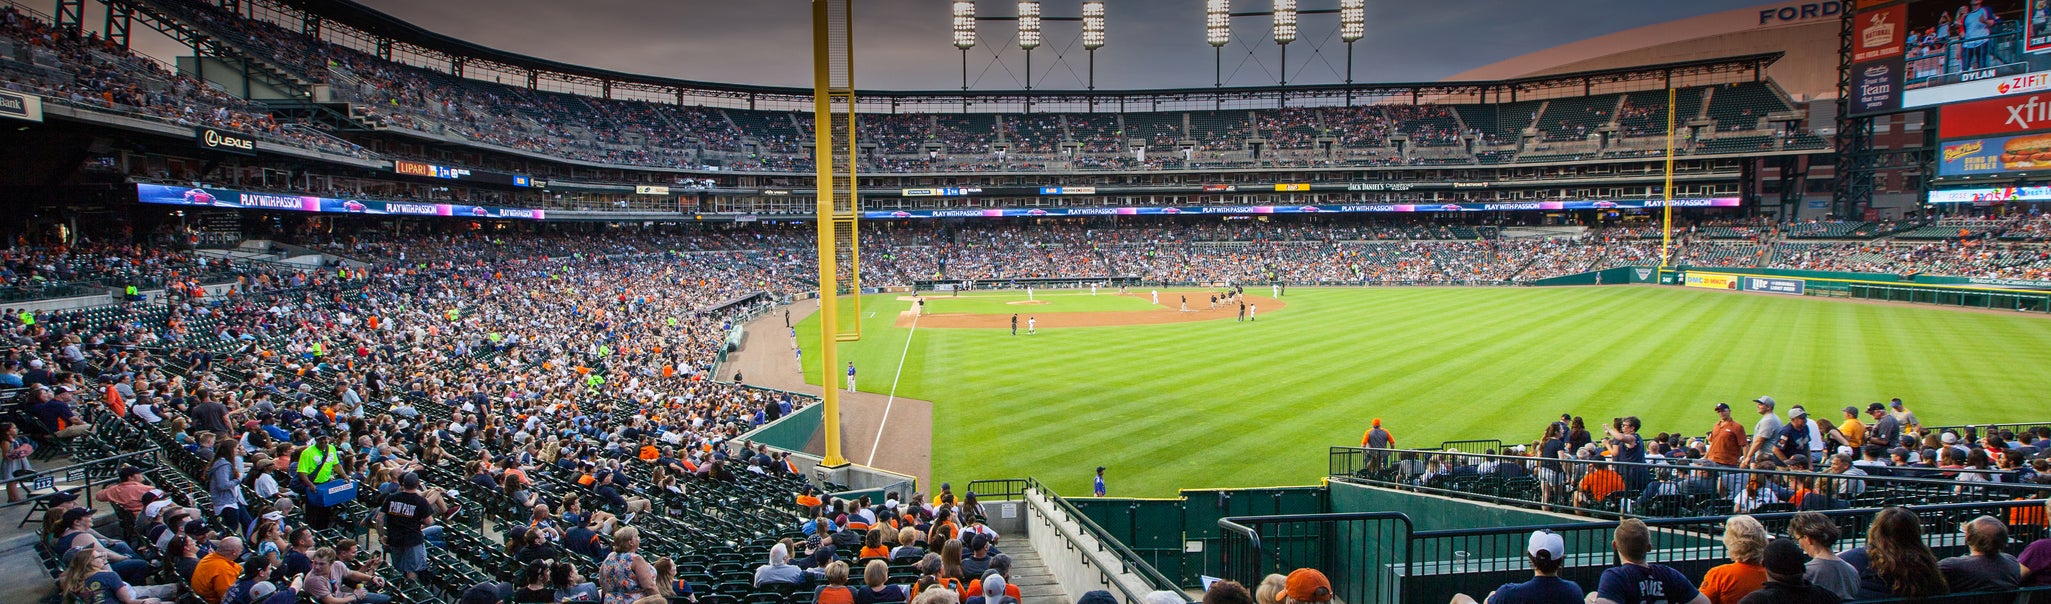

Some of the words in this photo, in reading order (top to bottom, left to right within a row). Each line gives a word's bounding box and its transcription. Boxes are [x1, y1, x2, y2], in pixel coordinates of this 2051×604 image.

[1759, 1, 1841, 25] FORD
[1961, 68, 1996, 82] DYLAN
[1860, 84, 1890, 96] Team
[0, 96, 21, 110] Bank
[218, 135, 253, 149] LEXUS
[401, 162, 426, 176] LIPARI
[1964, 162, 1998, 171] SUMMER
[240, 194, 258, 206] PLAY
[260, 195, 276, 207] WITH
[276, 196, 303, 209] PASSION
[1680, 199, 1711, 207] PASSION
[386, 203, 400, 213] PLAY
[400, 204, 416, 213] WITH
[415, 204, 437, 214] PASSION
[1687, 276, 1703, 284] DMC
[1752, 278, 1768, 290] Lite
[36, 480, 52, 489] 112
[389, 501, 403, 514] PAW
[402, 503, 417, 517] PAW
